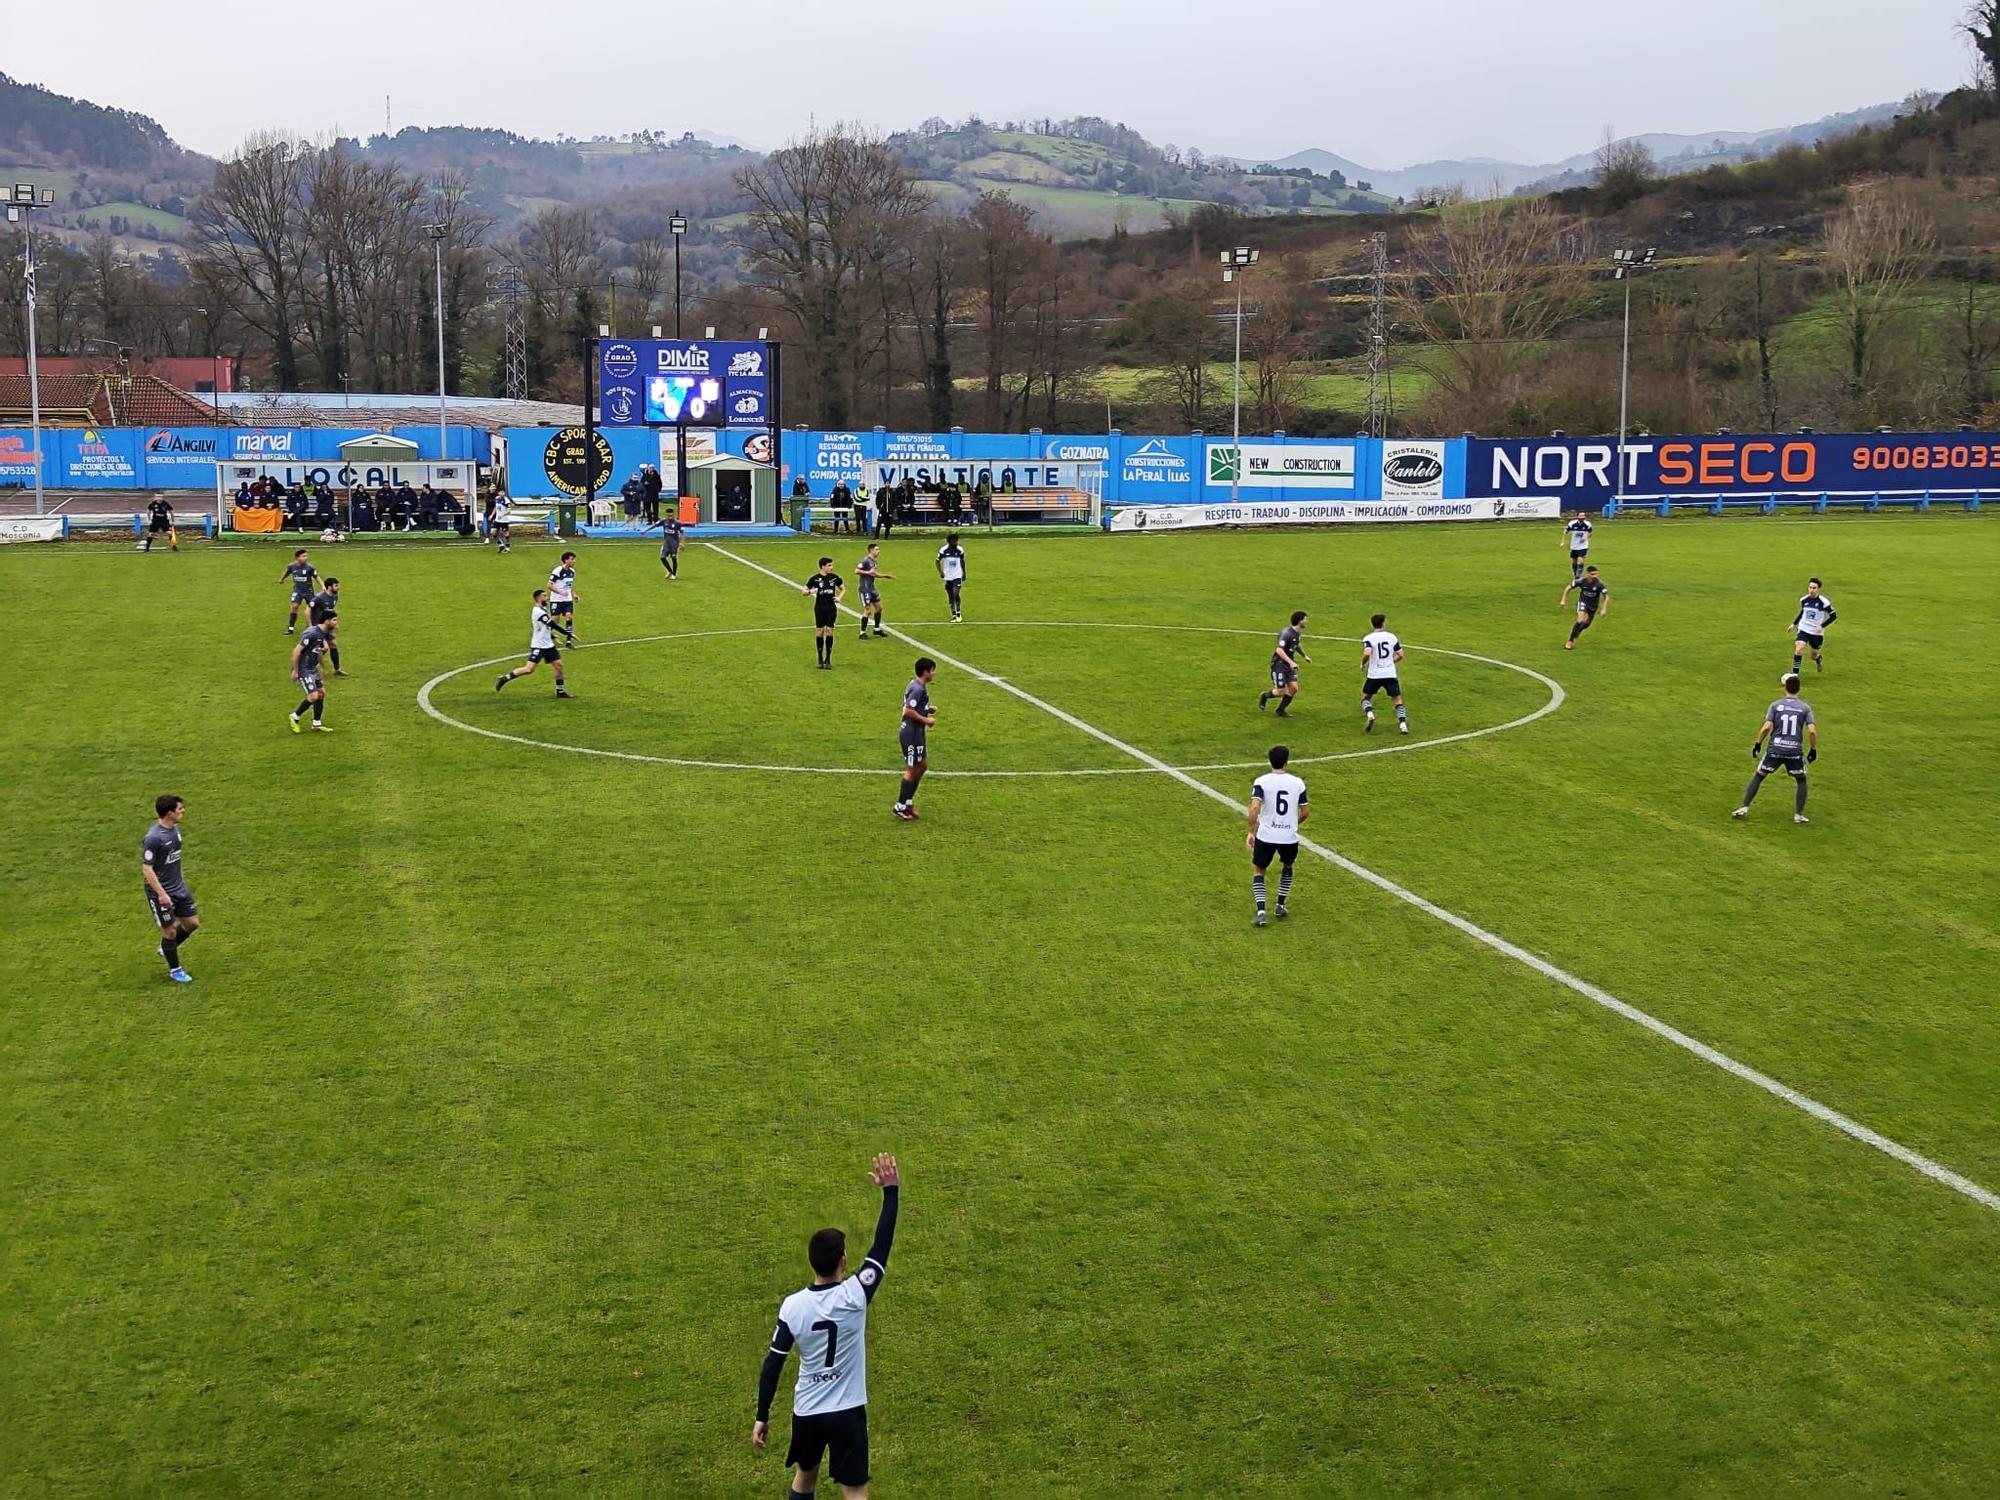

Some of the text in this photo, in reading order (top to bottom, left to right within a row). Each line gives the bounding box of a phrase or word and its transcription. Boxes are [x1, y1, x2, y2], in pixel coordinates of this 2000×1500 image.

[729, 389, 764, 398] ALMACENES
[728, 415, 764, 423] LORENCES
[171, 435, 216, 452] ANGILVI
[236, 431, 291, 451] marval
[824, 434, 838, 442] BAR
[546, 428, 612, 467] CBC SPORS BAR
[566, 447, 585, 456] GRAD
[818, 443, 862, 451] RESTAURANTE
[886, 443, 946, 452] PUENTE DE PEÑAFLOR
[1060, 446, 1110, 460] GOZNATRA
[1387, 448, 1438, 458] CRISTALERIA
[146, 456, 216, 464] SERVICIOS INTEGRALES
[817, 451, 863, 468] CASA
[1125, 457, 1186, 467] CONSTRUCCIONES
[1250, 458, 1341, 471] NEW CONSTRUCTION
[0, 466, 36, 475] 5753328
[70, 463, 132, 471] DIRECCIONES DE OBRA
[1385, 459, 1440, 478] Canteli
[286, 467, 409, 488] LOCAL
[809, 470, 862, 480] COMIDA CASE
[1123, 468, 1135, 481] LA
[1135, 468, 1165, 482] PERAL
[1167, 468, 1191, 482] ILLAS
[547, 470, 588, 496] AMERICAN
[1205, 503, 1472, 521] RESPETO TRABAJO DISCIPLINA IMPLICACIÓN COMPROMISO
[1377, 641, 1390, 659] 15
[1780, 714, 1798, 736] 11
[1276, 790, 1289, 816] 6
[811, 1320, 838, 1368] 7
